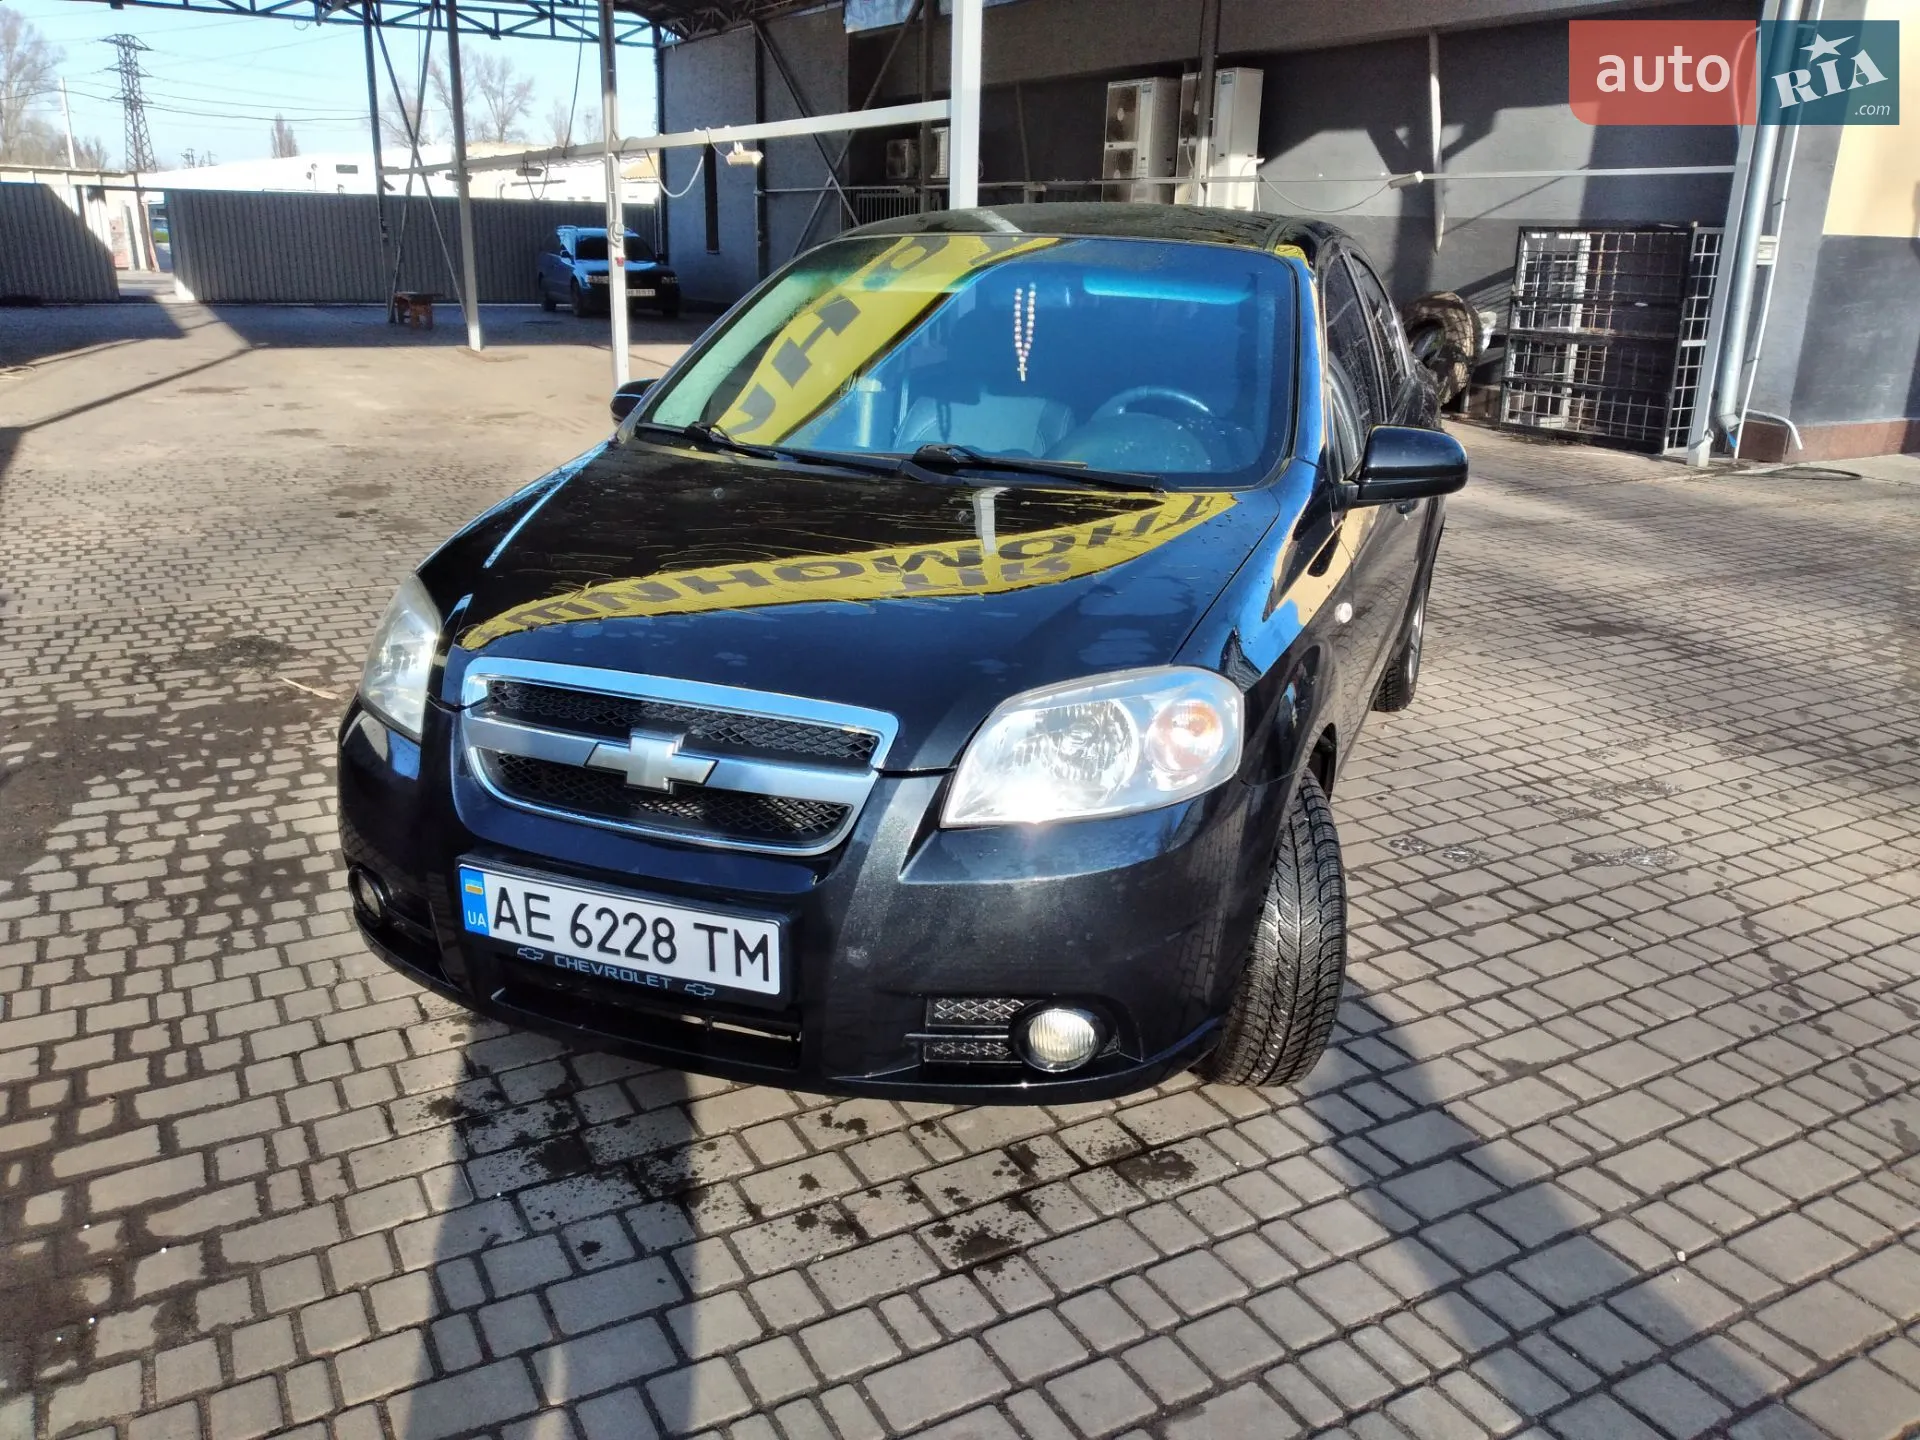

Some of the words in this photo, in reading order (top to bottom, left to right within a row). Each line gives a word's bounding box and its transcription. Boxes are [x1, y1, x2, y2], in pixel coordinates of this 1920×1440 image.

[467, 910, 487, 928] UA
[493, 887, 555, 943] AE
[569, 903, 678, 964] 6228
[693, 922, 770, 982] TM
[554, 954, 673, 989] CHEVROLET
